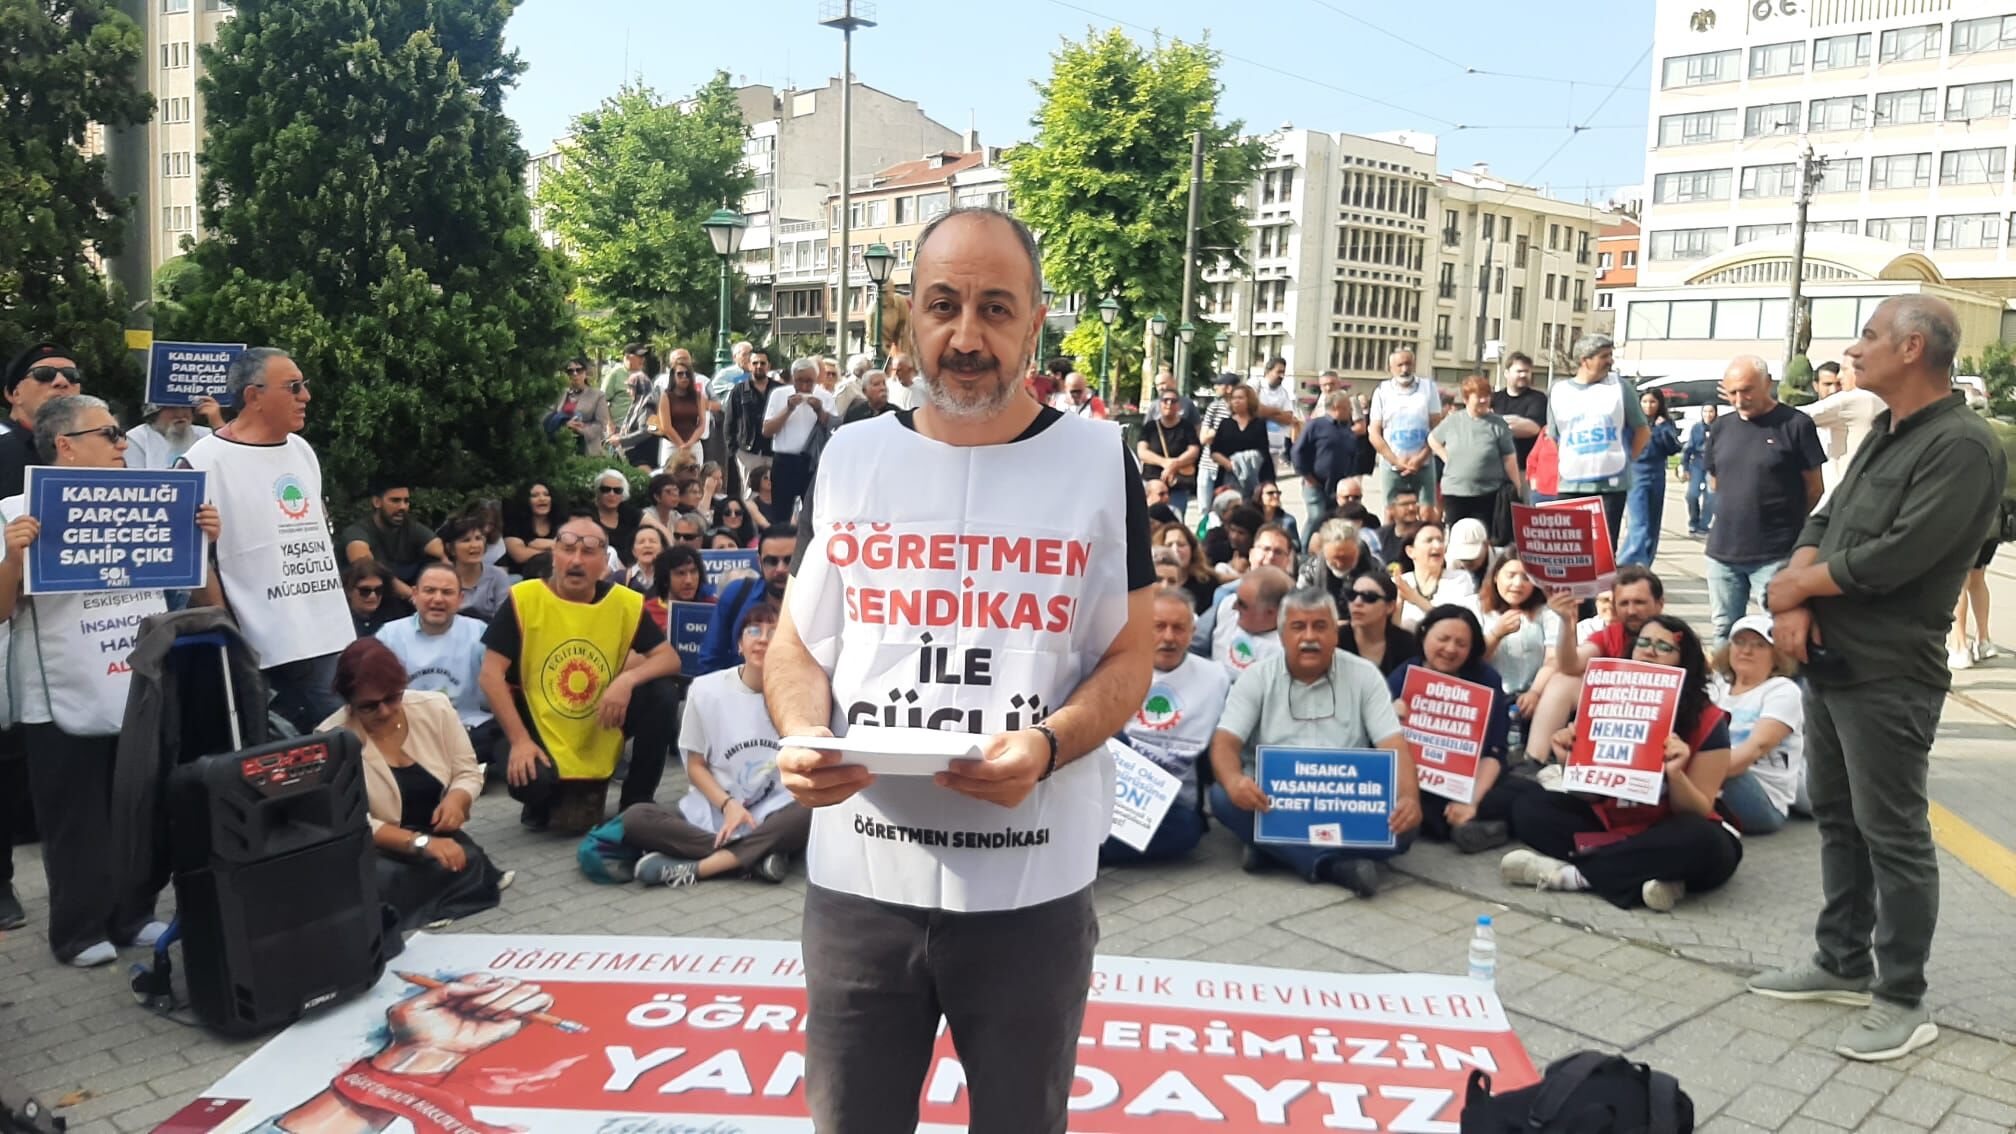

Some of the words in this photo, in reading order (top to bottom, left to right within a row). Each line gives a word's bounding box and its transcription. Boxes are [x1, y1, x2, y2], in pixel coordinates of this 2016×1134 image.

[168, 351, 230, 362] KARANLIĞI
[169, 373, 227, 383] GELECEĞE
[171, 363, 226, 374] PARÇALA
[166, 383, 204, 393] SAHİP
[62, 484, 178, 503] KARANLIĞI
[68, 507, 168, 527] PARÇALA
[1530, 514, 1571, 527] DÜŞÜK
[62, 524, 171, 544] GELECEĞE
[1522, 526, 1583, 540] ÜCRETLERE
[59, 544, 127, 565] SAHİP
[131, 547, 173, 567] ÇIK!
[280, 541, 326, 558] YAŞASIN
[826, 521, 1092, 577] ÖĞRETMEN
[1525, 540, 1582, 553] MÜLAKATA
[99, 567, 131, 581] SOL
[282, 556, 334, 577] ÖRGÜTLÜ
[83, 591, 152, 610] ESKİŞEHİR
[845, 576, 1078, 633] SENDİKASI
[919, 631, 993, 686] İLE
[1586, 668, 1680, 689] ÖĞRETMENLERE
[1425, 681, 1471, 703] DÜŞÜK
[1590, 686, 1665, 705] EMEKÇİLERE
[1410, 694, 1479, 721] ÜCRETLERE
[1588, 702, 1661, 721] EMEKLİLERE
[1408, 713, 1472, 736] MÜLAKATA
[1591, 722, 1646, 741] HEMEN
[1423, 748, 1443, 761] SON
[1595, 743, 1629, 761] ZAM
[1138, 767, 1166, 788] Okul
[1295, 760, 1358, 777] İNSANCA
[1418, 769, 1445, 786] HP
[1270, 779, 1355, 795] YAŞANACAK
[1358, 780, 1383, 796] BİR
[1584, 769, 1626, 789] EHP
[1314, 796, 1387, 814] İSTİYORUZ
[854, 813, 948, 848] ÖĞRETMEN
[952, 827, 1050, 849] SENDİKASI
[488, 947, 756, 976] ÖĞRETMENLER
[1195, 979, 1491, 1020] GREVİNDELER!
[626, 993, 807, 1033] ÖĞR
